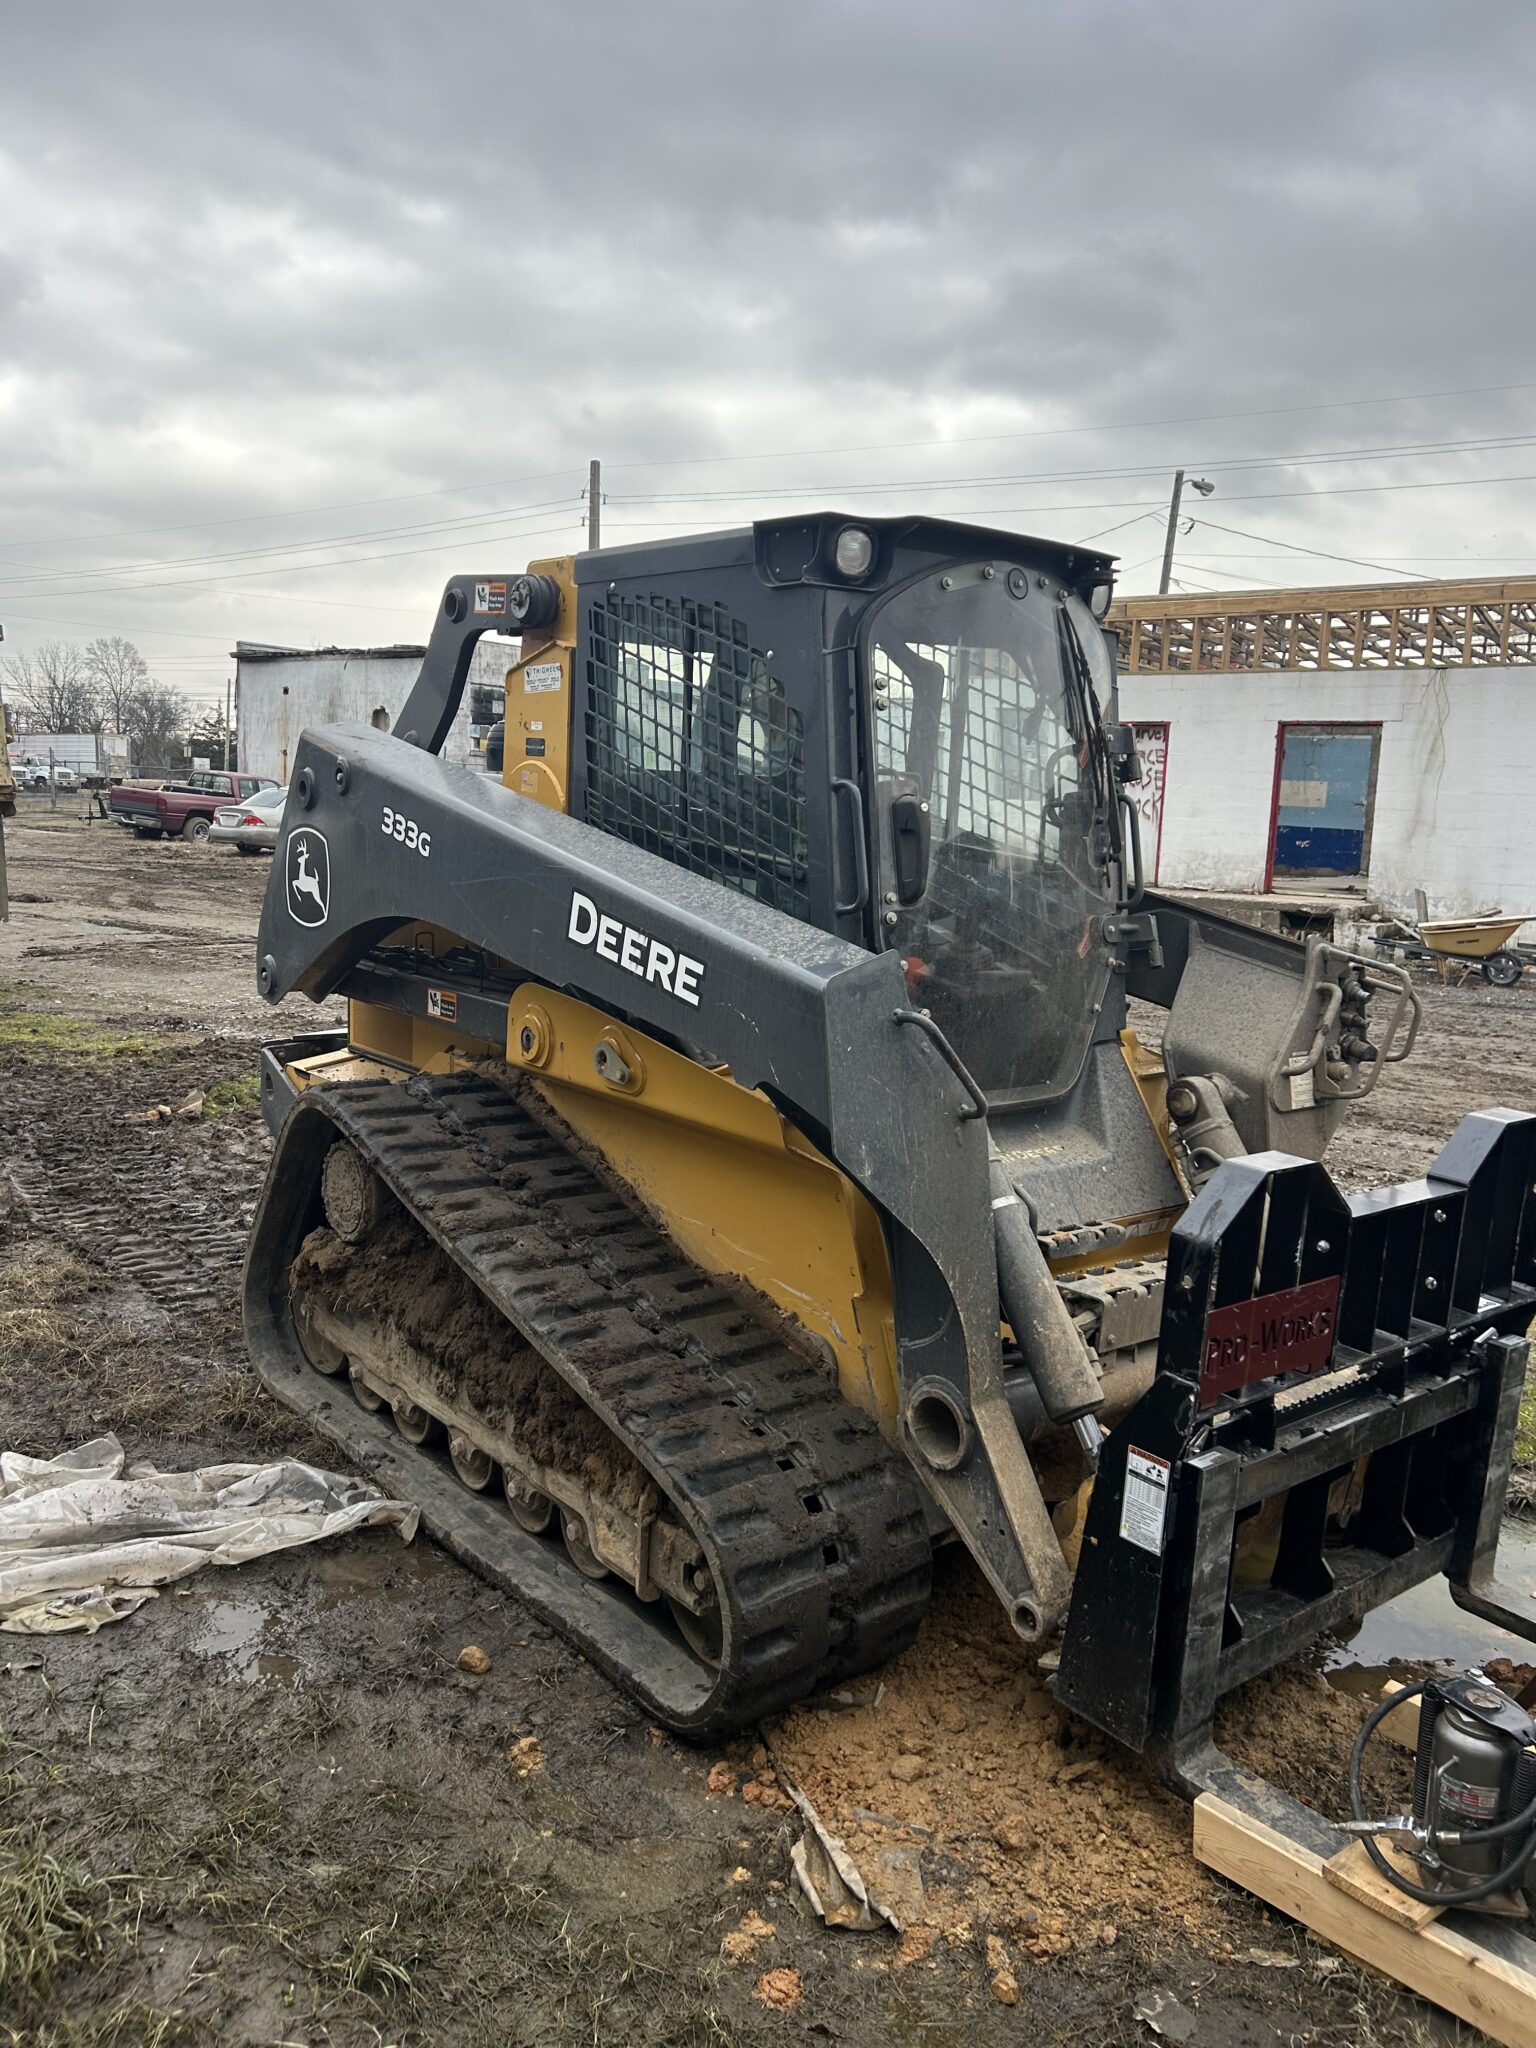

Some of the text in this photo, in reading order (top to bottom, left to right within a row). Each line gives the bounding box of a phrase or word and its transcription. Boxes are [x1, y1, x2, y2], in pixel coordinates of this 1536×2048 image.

[382, 806, 432, 858] 333G
[567, 891, 705, 1007] DEERE
[1203, 1307, 1334, 1376] PRO-WORKS
